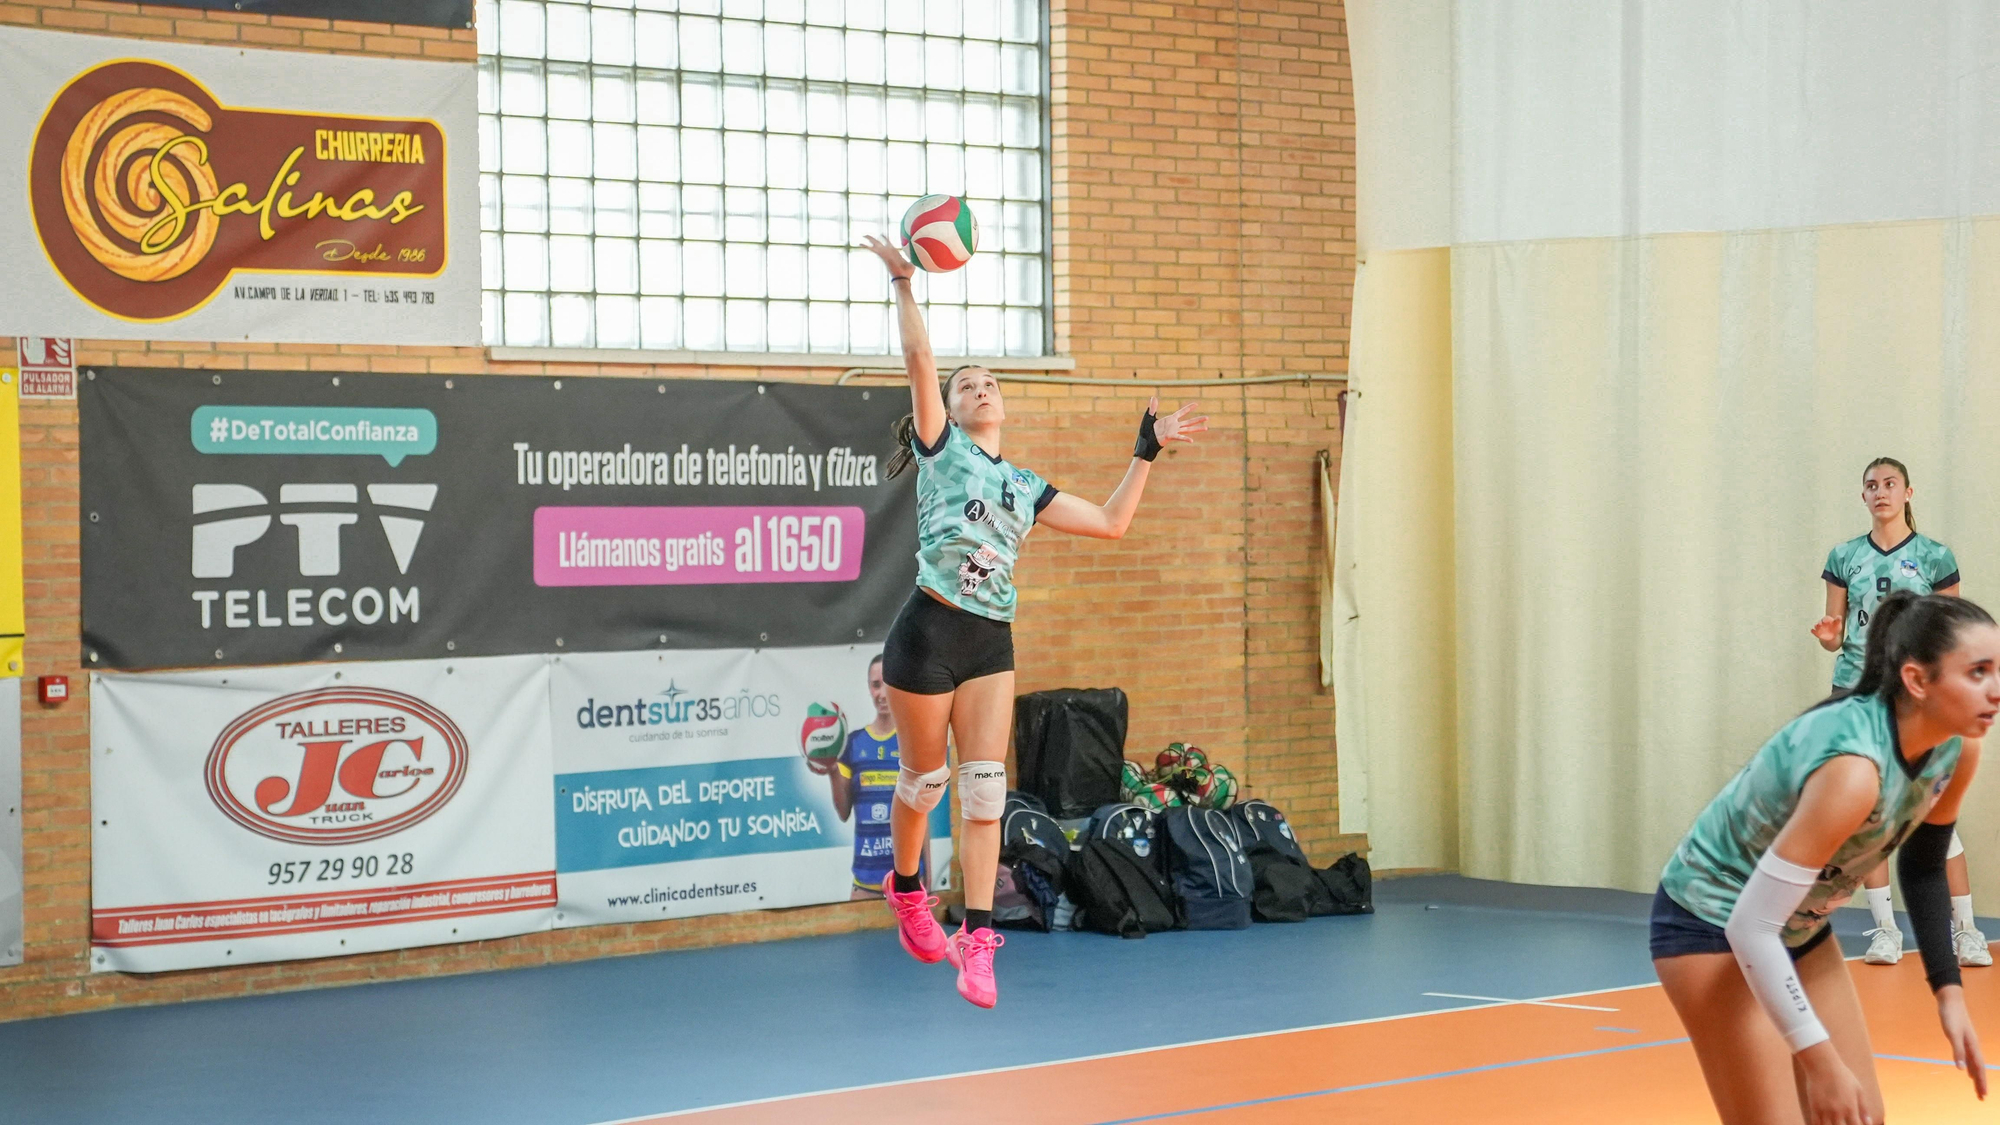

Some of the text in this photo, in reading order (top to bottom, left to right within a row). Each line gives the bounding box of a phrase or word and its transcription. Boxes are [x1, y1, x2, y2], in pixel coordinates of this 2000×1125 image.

[315, 129, 424, 164] CHURRERIA
[140, 135, 424, 254] Salinas
[315, 239, 426, 263] Desde 1986
[281, 287, 290, 300] DE
[295, 287, 305, 301] LA
[310, 288, 339, 302] VERDAD
[384, 290, 399, 304] 635
[403, 291, 417, 304] 493
[421, 291, 435, 304] 783
[23, 372, 71, 383] PULSADOR
[23, 383, 71, 394] DE ALARMA
[209, 417, 419, 442] #DeTotalConfianza
[513, 442, 878, 492] Tu operadora de telefonía y fibra
[191, 483, 439, 579] PTV
[559, 516, 842, 573] Llámanos gratis al 1650
[1876, 577, 1891, 601] 9
[191, 586, 420, 629] TELECOM
[275, 716, 406, 739] TALLERES
[629, 727, 729, 743] cuidando de tu sonrisa
[658, 780, 692, 806] DEL
[699, 776, 775, 804] DEPORTE
[309, 813, 374, 825] TRUCK
[718, 817, 740, 842] TU
[268, 853, 414, 886] 957 29 90 28
[607, 881, 757, 908] www.clinicadentsur.es
[118, 919, 153, 934] Talleres
[175, 914, 204, 930] Carlos
